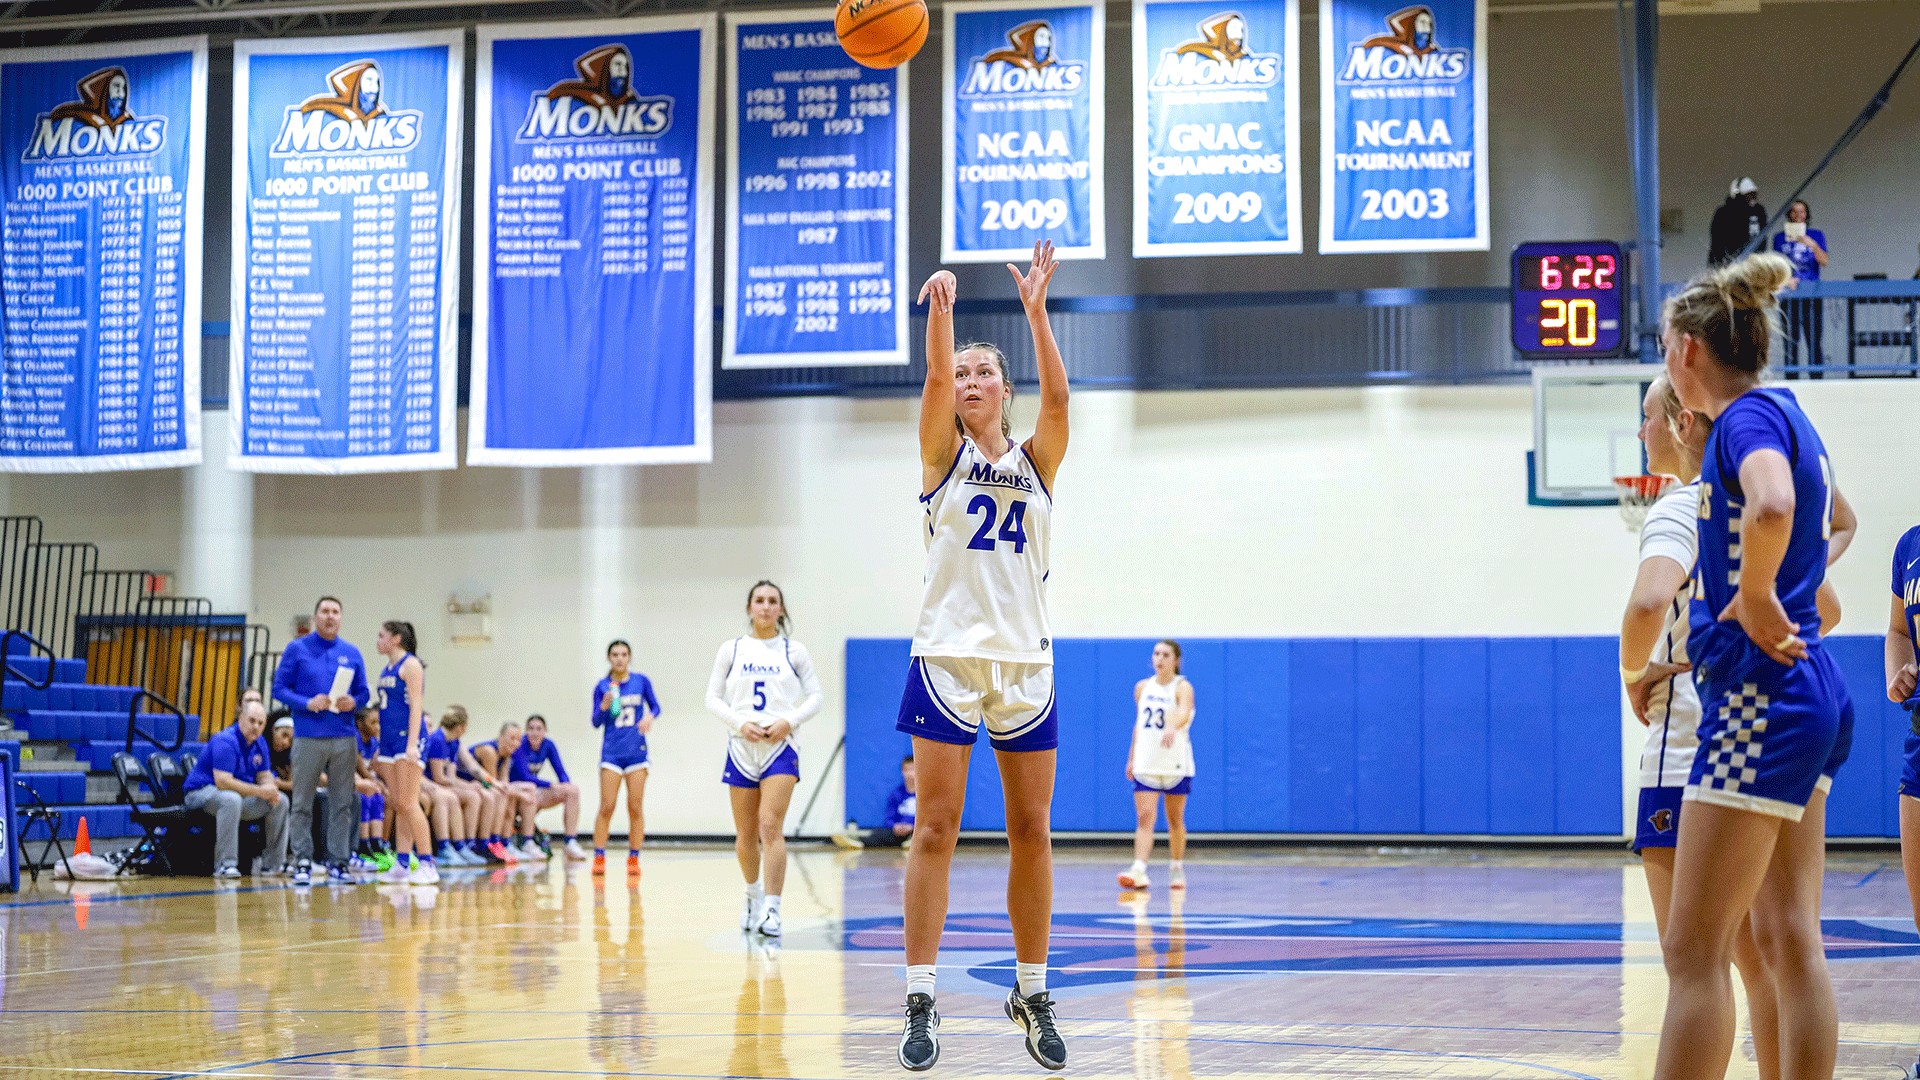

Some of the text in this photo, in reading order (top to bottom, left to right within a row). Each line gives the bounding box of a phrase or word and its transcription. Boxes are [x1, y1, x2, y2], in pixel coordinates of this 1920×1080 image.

[742, 34, 791, 51] MEN'S
[1156, 51, 1276, 86] MONKS
[1345, 45, 1466, 80] MONKS
[966, 60, 1082, 94] MONKS
[849, 83, 891, 101] 1985
[525, 95, 667, 137] MONKS
[746, 105, 786, 122] 1986
[797, 103, 838, 120] 1987
[29, 117, 164, 158] MONKS
[278, 110, 417, 151] MONKS
[771, 118, 864, 138] 1991 1993
[1168, 122, 1263, 152] GNAC
[1355, 119, 1452, 147] NCAA
[532, 141, 657, 159] MEN'S BASKETBALL
[976, 130, 1069, 158] NCAA
[34, 160, 154, 179] MEN'S BASKETBALL
[512, 157, 682, 182] 1000 POINT CLUB
[958, 161, 1088, 183] TOURNAMENT
[1148, 154, 1283, 176] CHAMPIONS
[1335, 151, 1473, 171] TOURNAMENT
[17, 175, 173, 201] 1000 POINT CLUB
[265, 171, 429, 196] 1000 POINT CLUB
[745, 169, 892, 193] 1996 1998 2002
[980, 199, 1068, 231] 2009
[1172, 191, 1262, 223] 2009
[1360, 188, 1450, 220] 2003
[797, 227, 838, 245] 1987
[745, 278, 892, 300] 1987 1992 1993
[745, 296, 892, 317] 1996 1998 1999
[795, 315, 838, 333] 2002
[1540, 298, 1597, 347] 20
[967, 461, 1033, 490] MONKS
[966, 493, 1028, 554] 24
[752, 681, 767, 712] 5
[1143, 706, 1166, 730] 23
